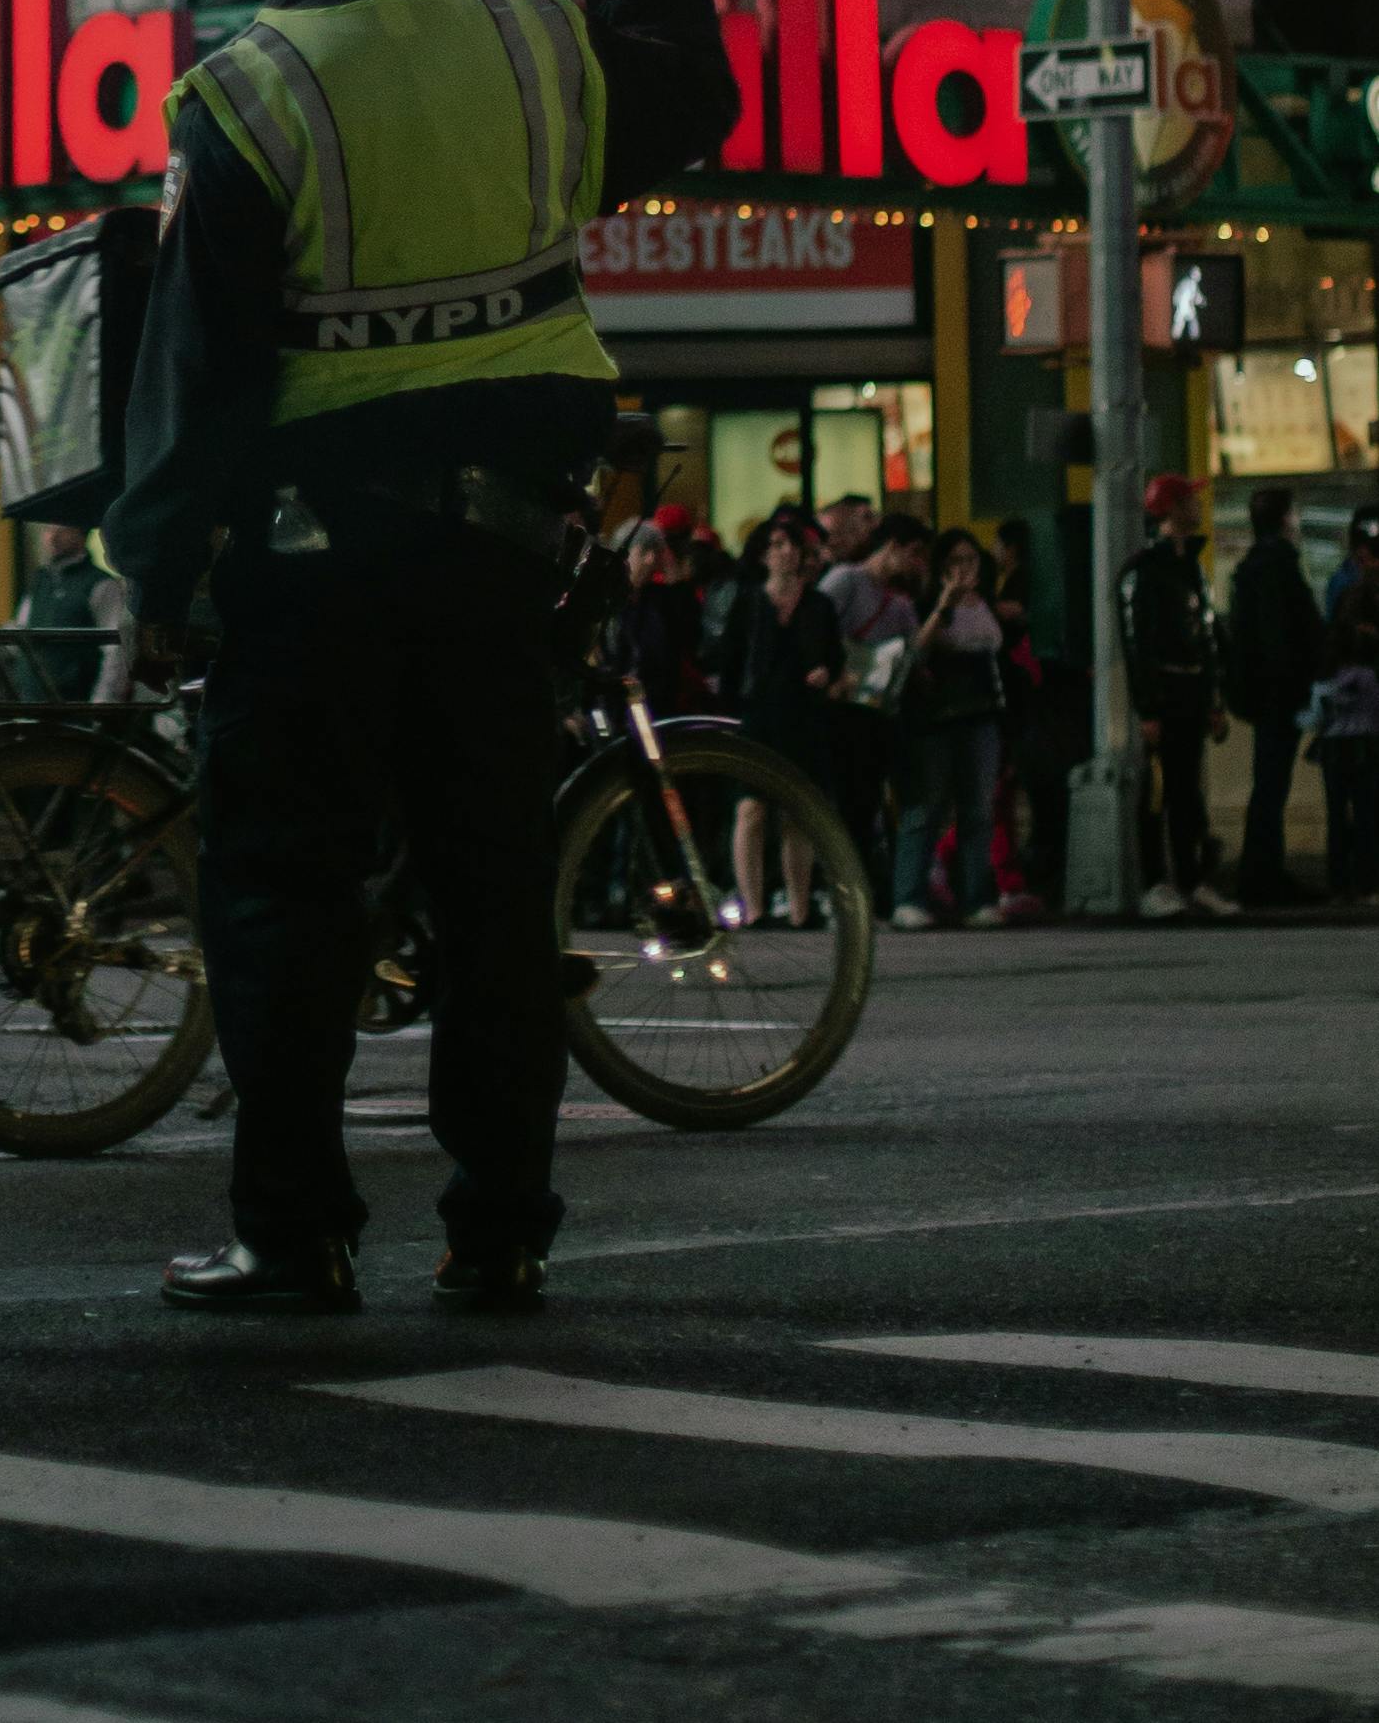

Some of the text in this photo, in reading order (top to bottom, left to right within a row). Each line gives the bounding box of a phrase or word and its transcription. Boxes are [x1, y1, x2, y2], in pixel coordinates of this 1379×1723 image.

[1040, 62, 1134, 95] ONE WAY
[578, 207, 856, 274] ESESTEAKS
[317, 288, 524, 349] NYPD
